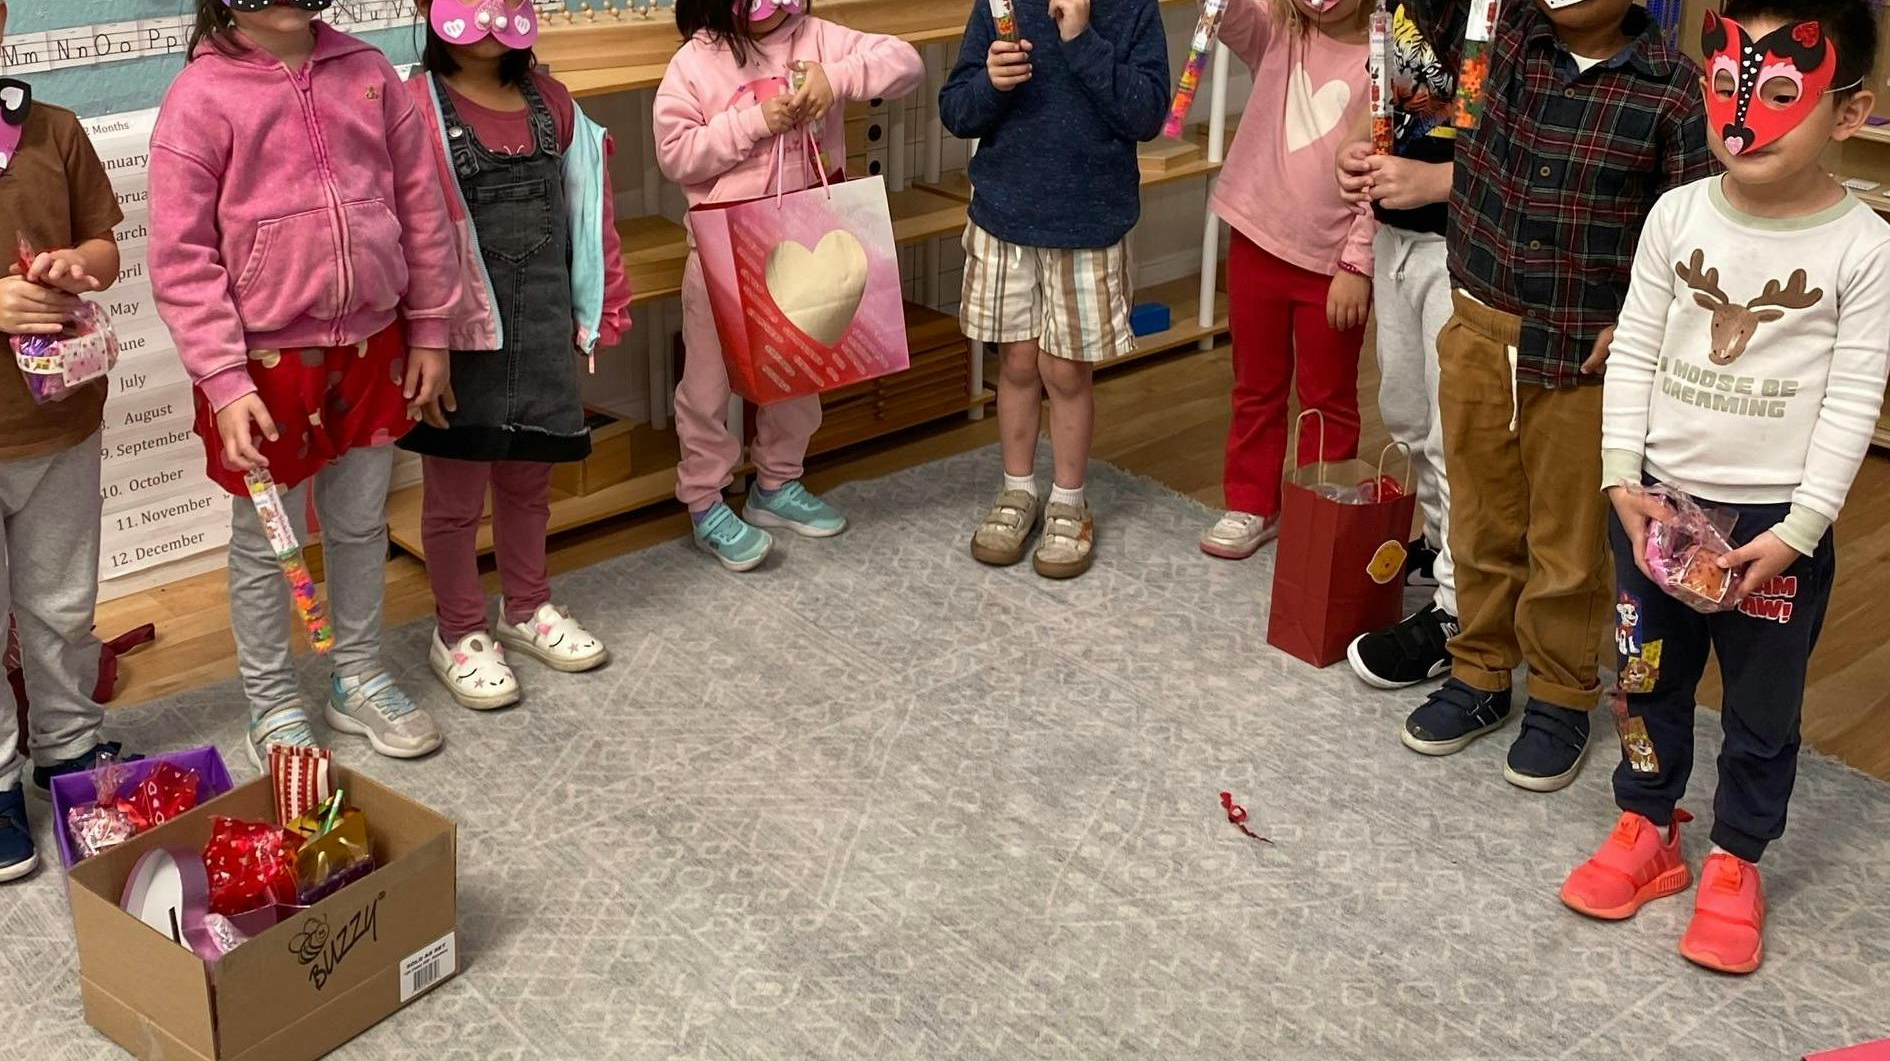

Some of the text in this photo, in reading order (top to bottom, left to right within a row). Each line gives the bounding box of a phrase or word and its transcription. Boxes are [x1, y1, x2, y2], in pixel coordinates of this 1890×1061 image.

[92, 120, 130, 135] Months
[101, 153, 149, 171] nuary
[115, 190, 148, 205] brua
[116, 225, 147, 241] arch
[117, 263, 142, 283] pril
[110, 301, 139, 317] May
[119, 337, 145, 352] une
[120, 373, 146, 392] July
[1660, 356, 1799, 397] I MOOSE BE
[1662, 376, 1786, 418] DREAMING
[124, 403, 173, 426] August
[100, 429, 192, 460] 9. September
[101, 468, 184, 500] 10. October
[116, 496, 213, 532] 11. November
[111, 532, 206, 568] 12. December
[1737, 595, 1793, 624] AW!
